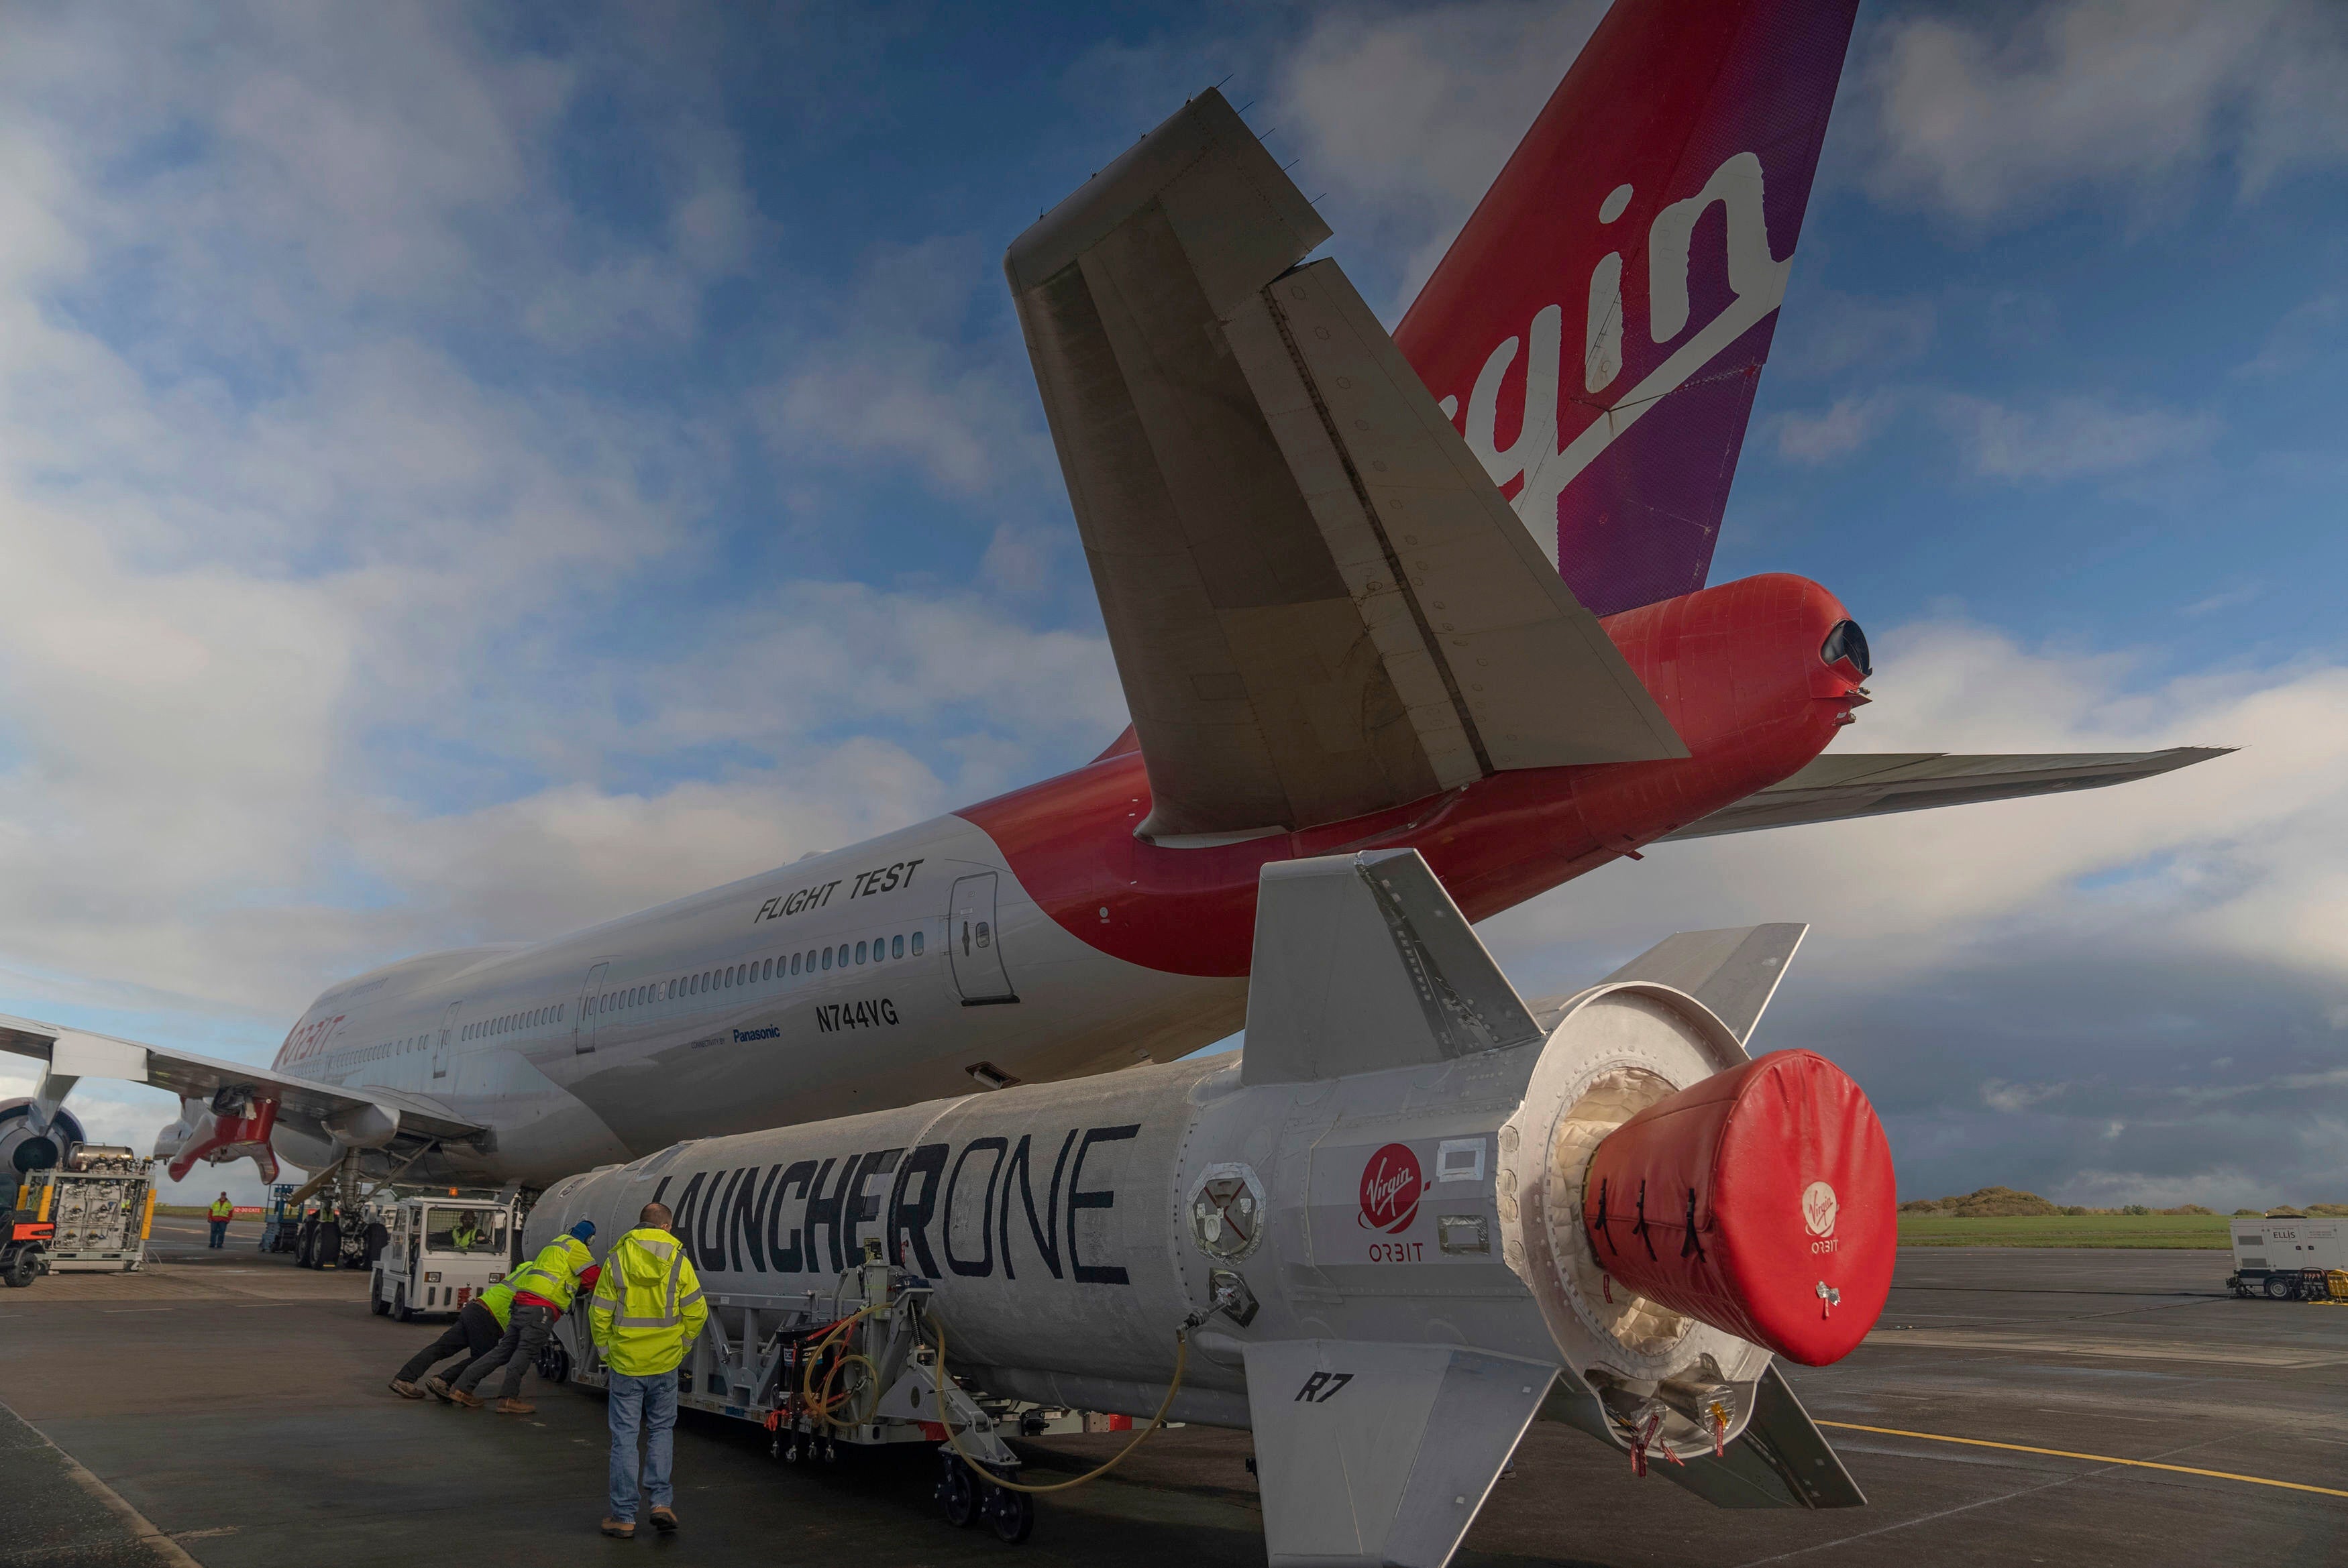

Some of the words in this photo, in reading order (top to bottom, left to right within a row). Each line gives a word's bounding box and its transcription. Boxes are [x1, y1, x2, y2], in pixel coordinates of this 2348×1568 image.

[754, 879, 842, 924] FLIGHT
[850, 858, 925, 899] TEST
[816, 997, 900, 1033] N744VG
[733, 1023, 781, 1044] Panasonic
[1367, 1157, 1414, 1217] Virgin
[1809, 1190, 1833, 1227] Virgin
[1811, 1239, 1839, 1254] ORBIT
[2273, 1230, 2296, 1240] ELLIS
[1369, 1243, 1423, 1262] ORBIT
[1294, 1371, 1354, 1402] R7
